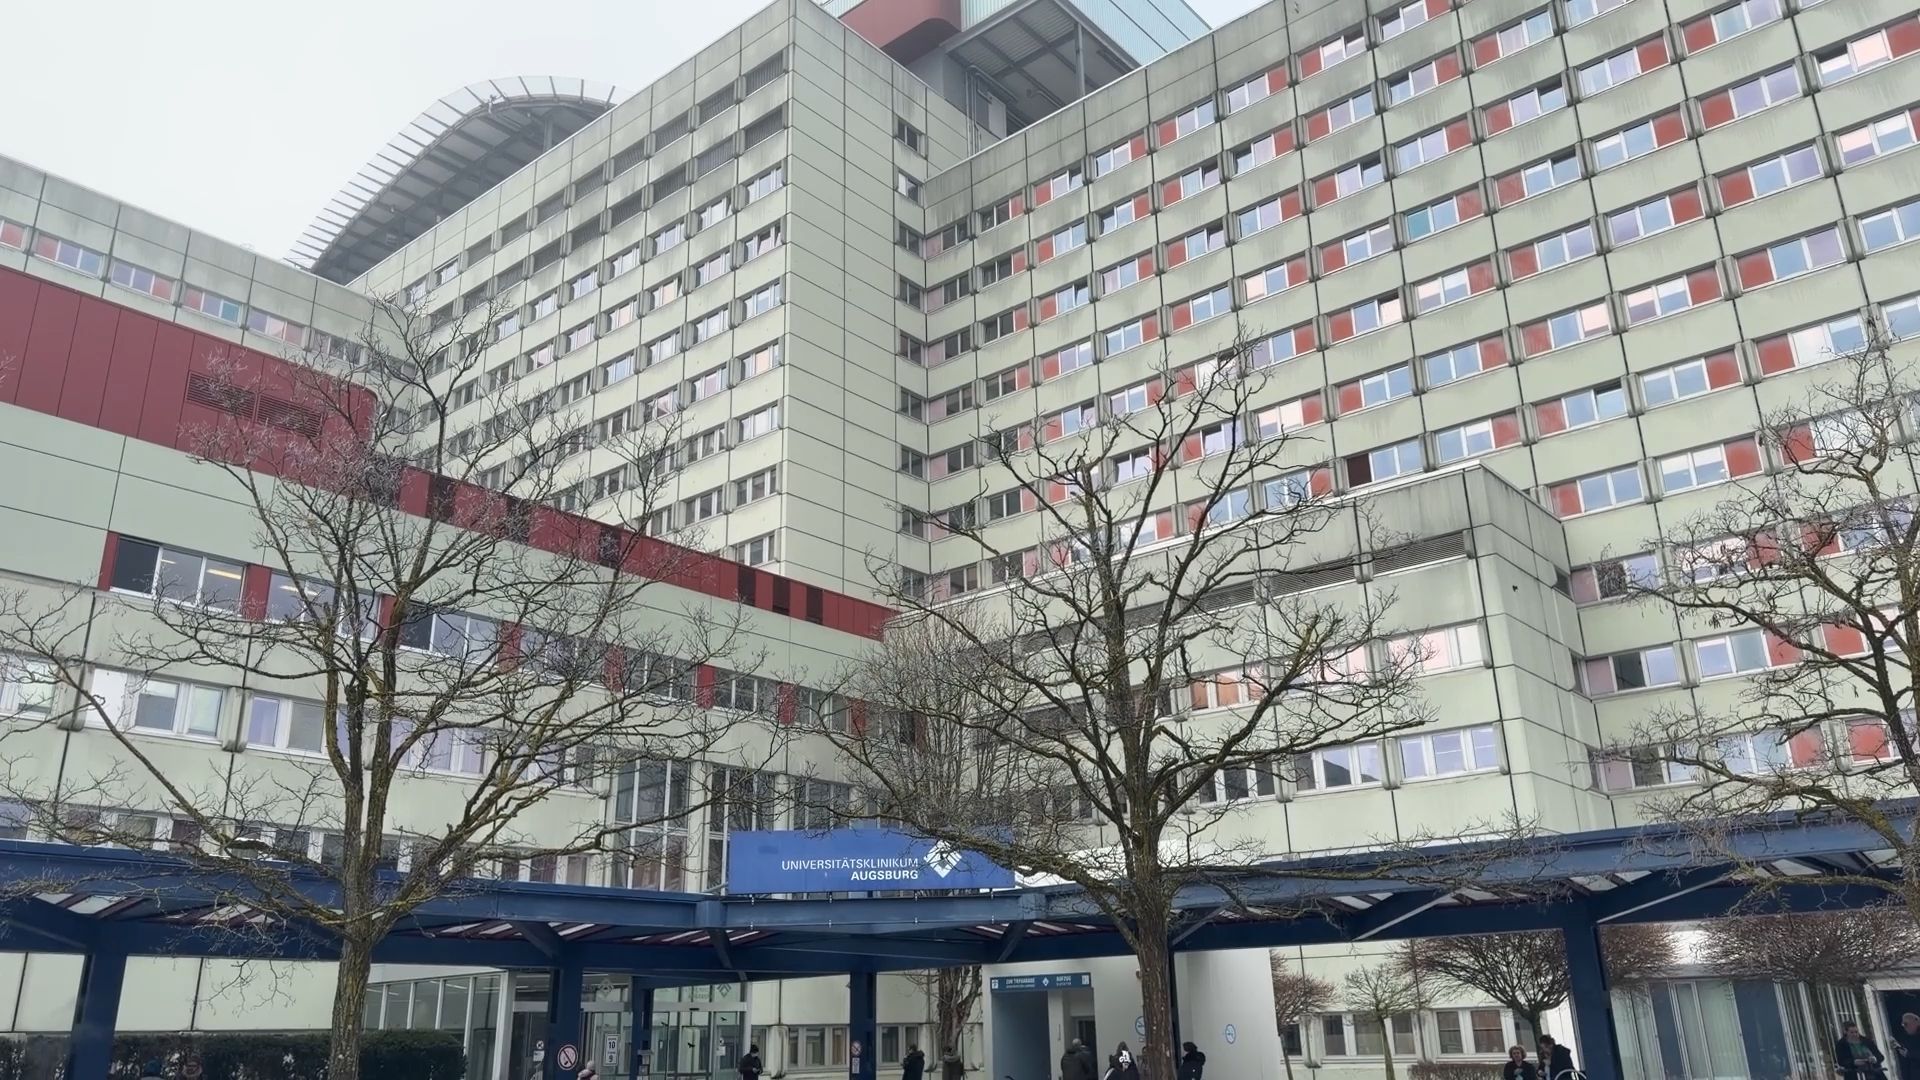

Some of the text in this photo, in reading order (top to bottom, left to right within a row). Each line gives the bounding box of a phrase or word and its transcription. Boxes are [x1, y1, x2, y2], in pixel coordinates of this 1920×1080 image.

[781, 857, 919, 871] UNIVERSITÄTSKLINIKUM
[850, 870, 919, 880] AUGSBURG
[608, 1041, 616, 1049] 10
